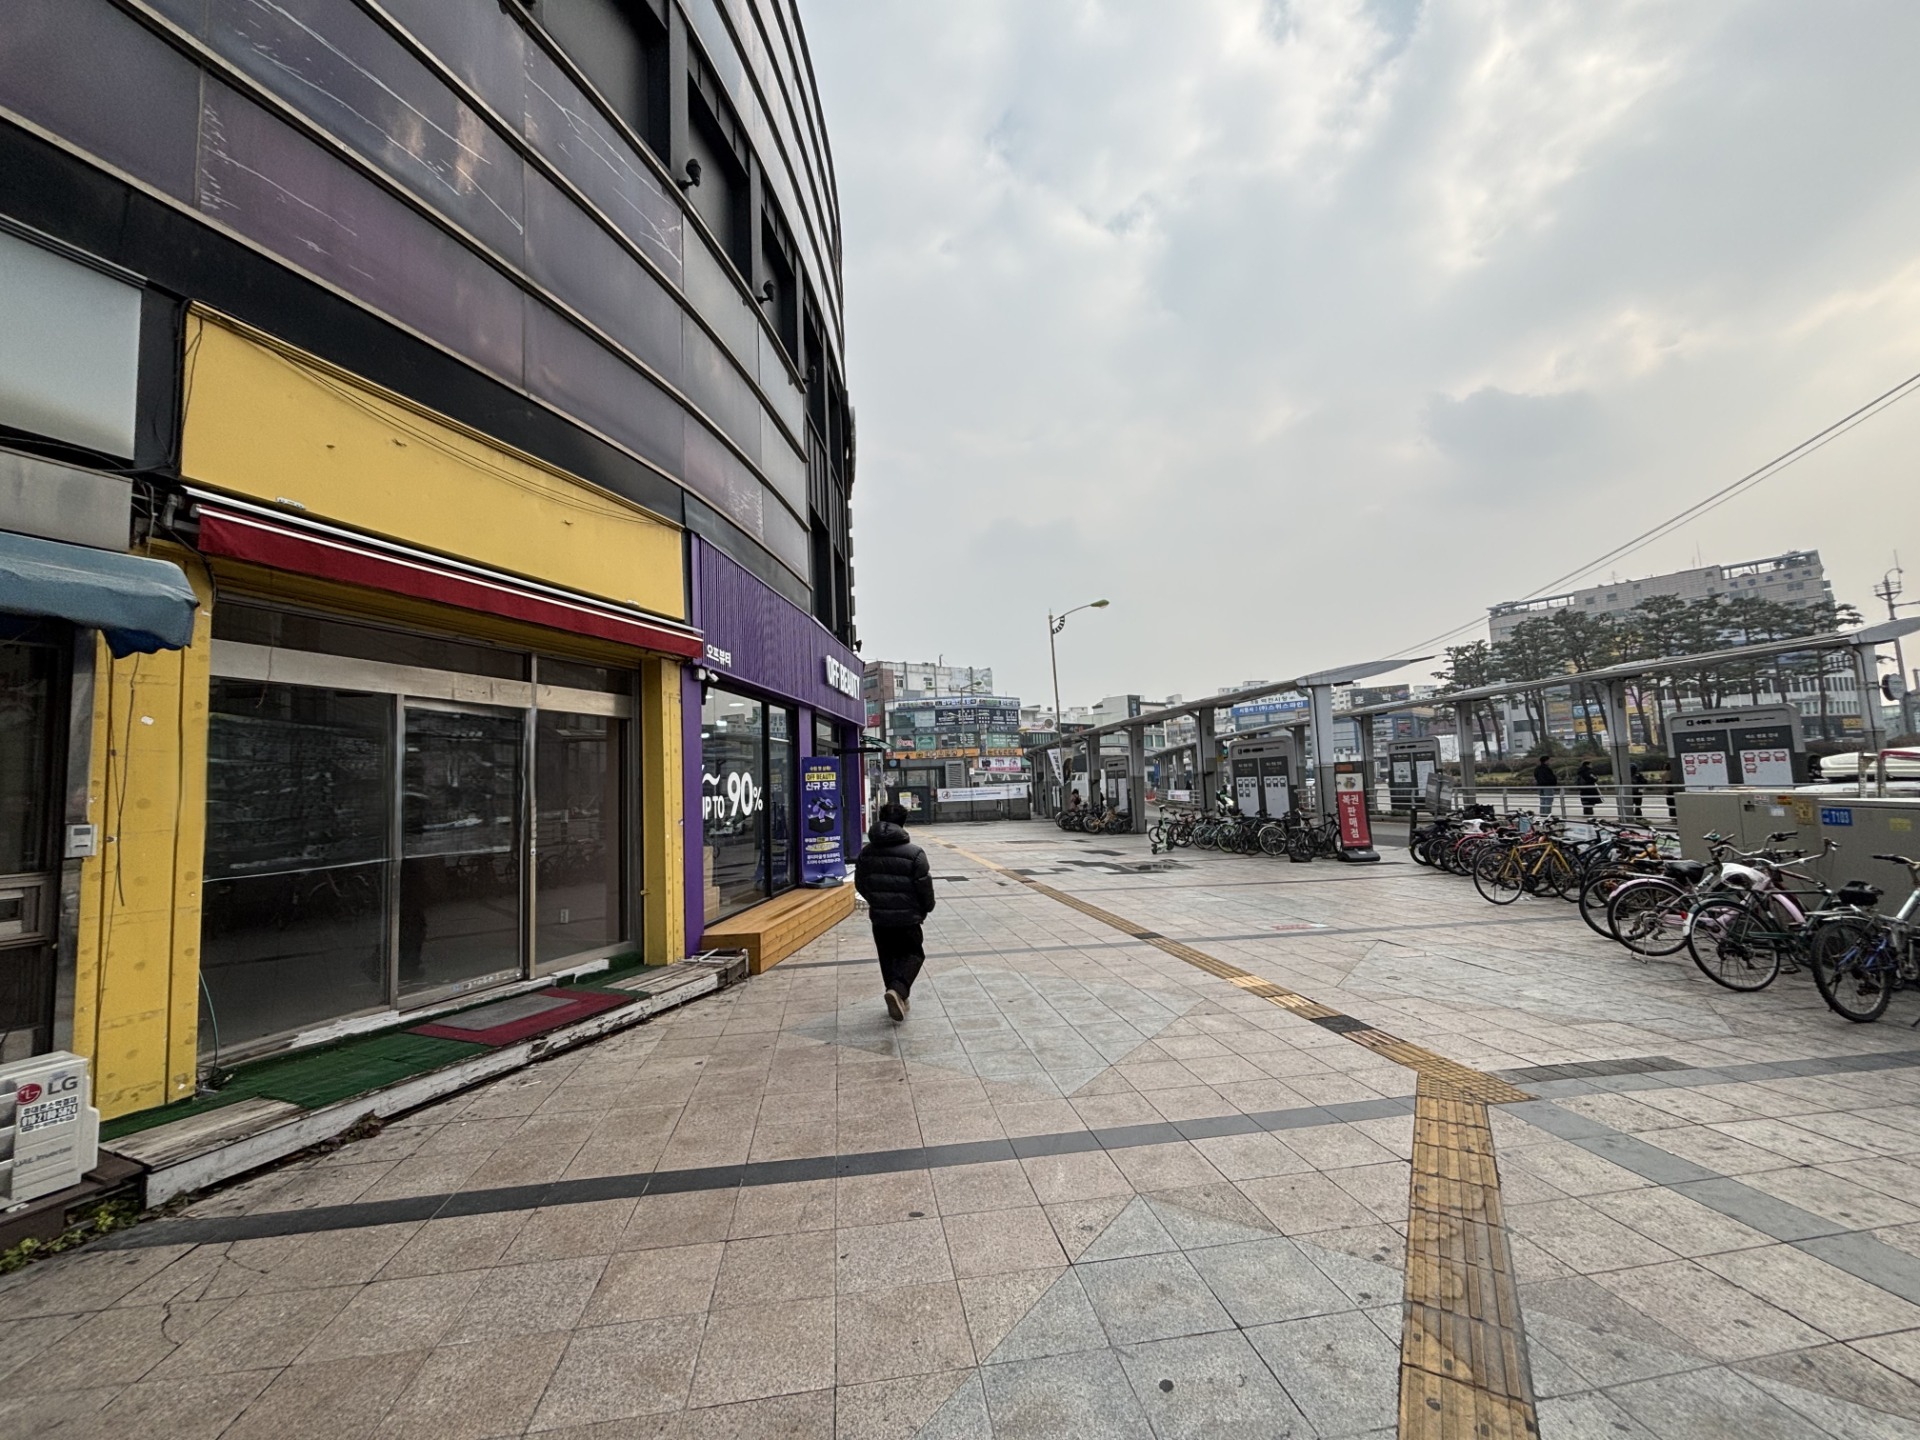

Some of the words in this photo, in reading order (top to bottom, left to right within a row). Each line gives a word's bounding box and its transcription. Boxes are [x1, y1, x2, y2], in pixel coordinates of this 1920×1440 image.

[825, 654, 840, 689] OFF
[839, 663, 860, 700] BEAUTY
[727, 771, 763, 816] 90%
[805, 782, 821, 791] 신규
[822, 781, 836, 790] 오픈
[47, 1076, 78, 1095] LG
